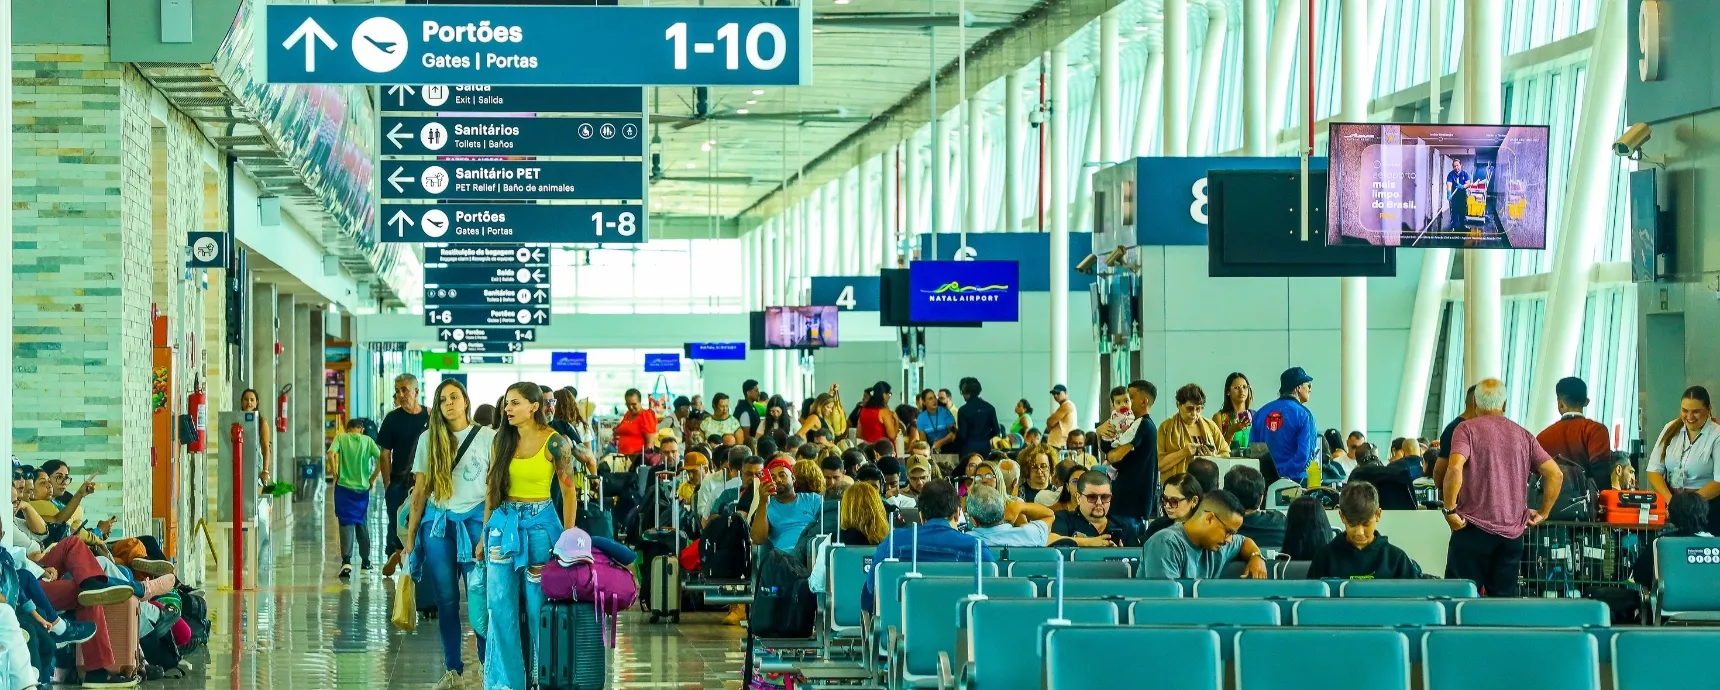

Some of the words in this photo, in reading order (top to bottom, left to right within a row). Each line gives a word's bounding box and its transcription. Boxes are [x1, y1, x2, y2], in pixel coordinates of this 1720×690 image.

[422, 20, 523, 43] Portões
[665, 22, 787, 70] 1-10
[422, 53, 471, 68] Gates
[486, 53, 539, 68] Portas
[455, 95, 471, 104] Exit
[478, 95, 504, 104] Salida
[454, 124, 520, 136] Sanitários
[454, 139, 482, 149] Toilets
[488, 139, 514, 149] Baños
[455, 167, 514, 180] Sanitário
[516, 167, 541, 180] PET
[455, 183, 471, 192] PET
[472, 183, 496, 192] Relief
[503, 183, 524, 192] Baño
[525, 183, 537, 192] de
[538, 183, 575, 192] animales
[1372, 180, 1396, 189] mais
[1372, 190, 1400, 199] limpo
[1371, 200, 1385, 209] do
[1386, 200, 1417, 209] Brasil.
[455, 211, 506, 223] Portões
[591, 211, 636, 237] 1-8
[455, 227, 480, 236] Gates
[487, 227, 513, 236] Portas
[836, 285, 857, 310] 4
[428, 310, 453, 324] 1-6
[514, 330, 533, 341] 1-4
